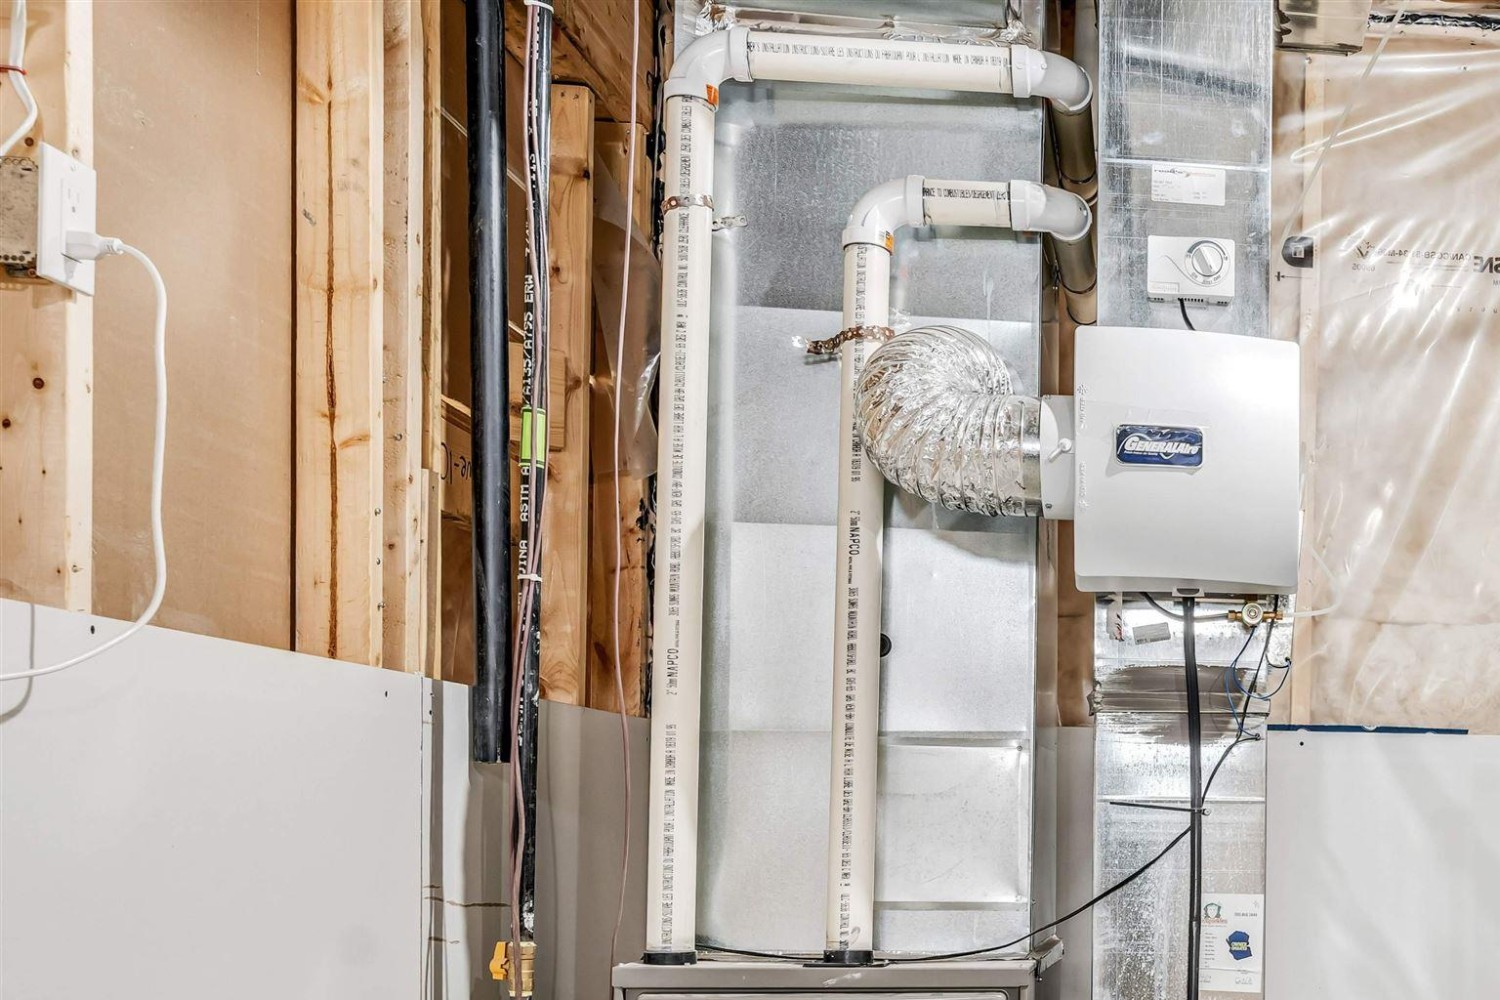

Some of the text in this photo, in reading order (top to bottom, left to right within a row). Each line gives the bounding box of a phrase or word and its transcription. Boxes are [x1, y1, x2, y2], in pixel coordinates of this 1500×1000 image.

[523, 274, 534, 303] ERW
[519, 484, 530, 522] ASTM
[848, 526, 861, 556] NAPCO
[666, 647, 680, 678] NAPCO
